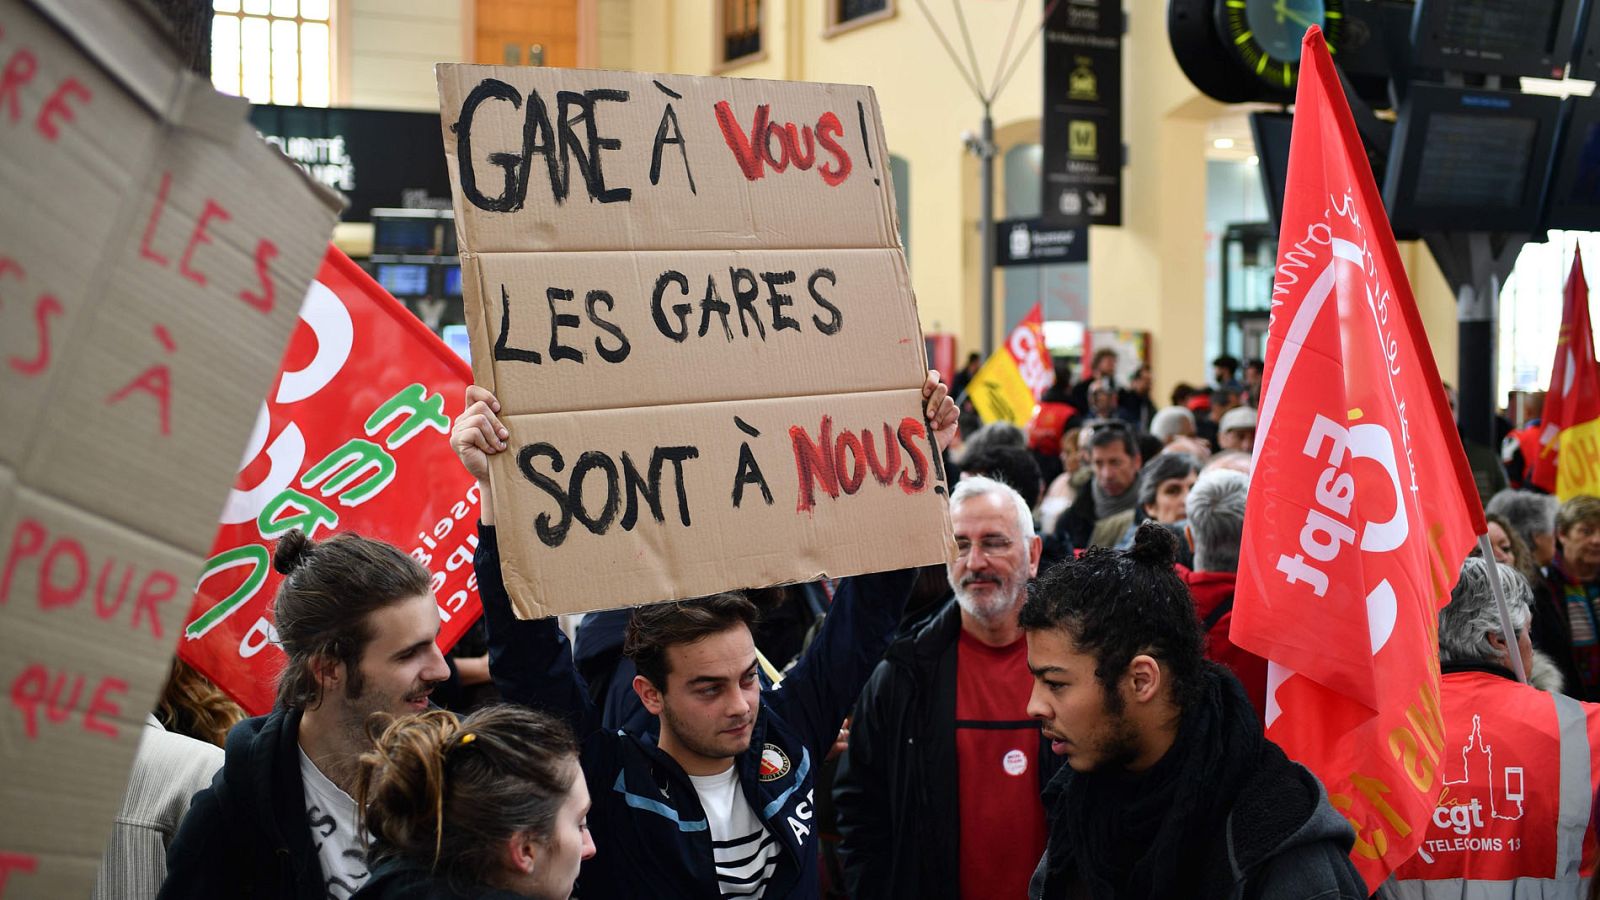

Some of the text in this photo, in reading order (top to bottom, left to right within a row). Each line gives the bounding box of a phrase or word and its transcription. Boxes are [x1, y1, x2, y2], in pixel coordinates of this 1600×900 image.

[0, 47, 94, 142] RE
[450, 78, 633, 213] GARE
[650, 80, 697, 196] À
[139, 171, 281, 315] LES
[495, 266, 844, 365] LES GARES
[104, 323, 177, 437] À
[516, 441, 699, 548] SONT
[731, 416, 774, 509] À
[1, 517, 179, 639] POUR
[10, 663, 129, 741] QUE
[1425, 838, 1522, 853] TELECOMS 13
[1432, 798, 1484, 835] cgt
